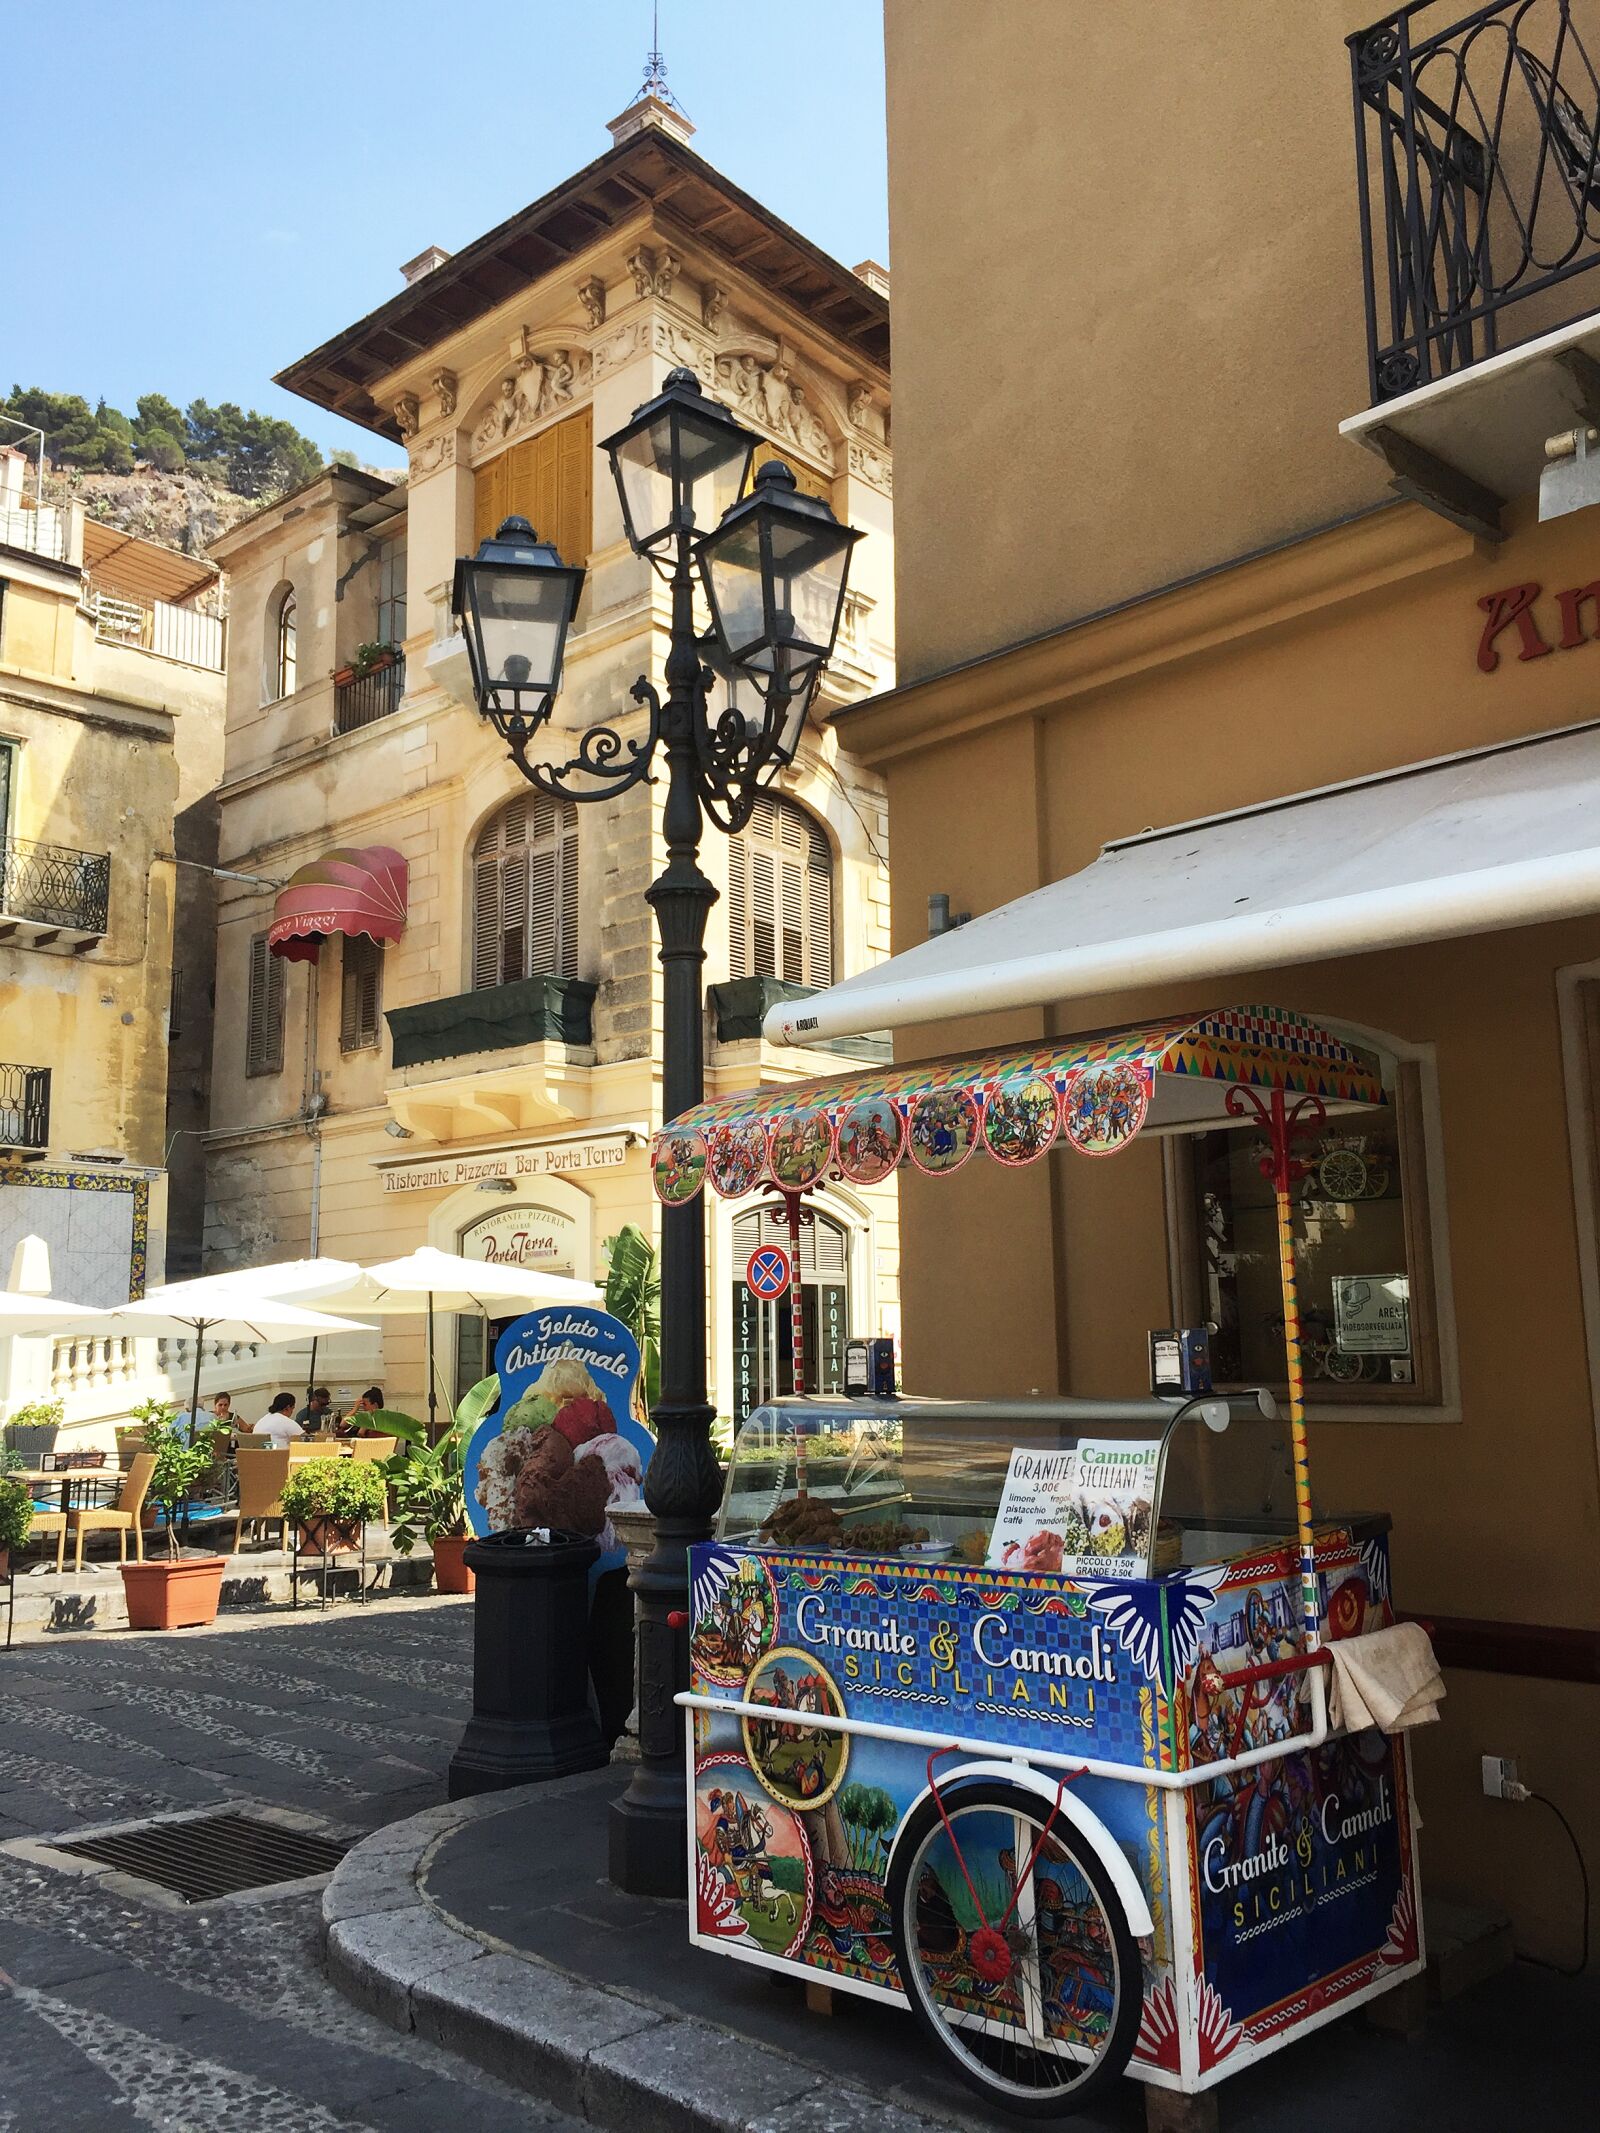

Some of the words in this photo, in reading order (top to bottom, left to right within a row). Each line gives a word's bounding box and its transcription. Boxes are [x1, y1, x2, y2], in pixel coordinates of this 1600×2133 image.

[294, 911, 337, 929] Viaggi
[386, 1168, 449, 1191] Ristorante
[455, 1160, 507, 1182] Pizzeria
[515, 1154, 539, 1174] Bar
[545, 1150, 581, 1170] Porta
[584, 1145, 623, 1166] Terra
[474, 1211, 521, 1237] RISTORANTE
[528, 1211, 566, 1229] PIZZERIA
[481, 1235, 518, 1263] Porta
[511, 1232, 553, 1263] Terra
[1378, 1307, 1401, 1318] AREA
[537, 1313, 599, 1341] Gelato
[830, 1291, 838, 1372] PORTA
[1342, 1321, 1403, 1332] VIDEOSORVEGLIATA
[505, 1342, 630, 1380] Artigianale
[741, 1287, 750, 1424] RISTOBRU
[1013, 1455, 1072, 1480] GRANITE
[1081, 1447, 1155, 1465] Cannoli
[1032, 1482, 1060, 1494] 3,00€
[1078, 1465, 1138, 1489] SICILIANI
[1005, 1505, 1046, 1515] pistacchio
[1009, 1493, 1036, 1503] limone
[1050, 1493, 1072, 1505] fragol
[1075, 1557, 1112, 1566] PICCOLO
[1115, 1560, 1135, 1569] 1,50€
[1075, 1567, 1110, 1576] GRANDE
[795, 1595, 917, 1657] Granite
[929, 1620, 959, 1672] &
[972, 1613, 1117, 1684] Cannoli
[843, 1654, 1096, 1713] SICILIANI
[1203, 1831, 1290, 1894] Granite
[1296, 1816, 1314, 1868] &
[1321, 1774, 1393, 1845] Cannoli
[1233, 1843, 1378, 1928] SICILIANI
